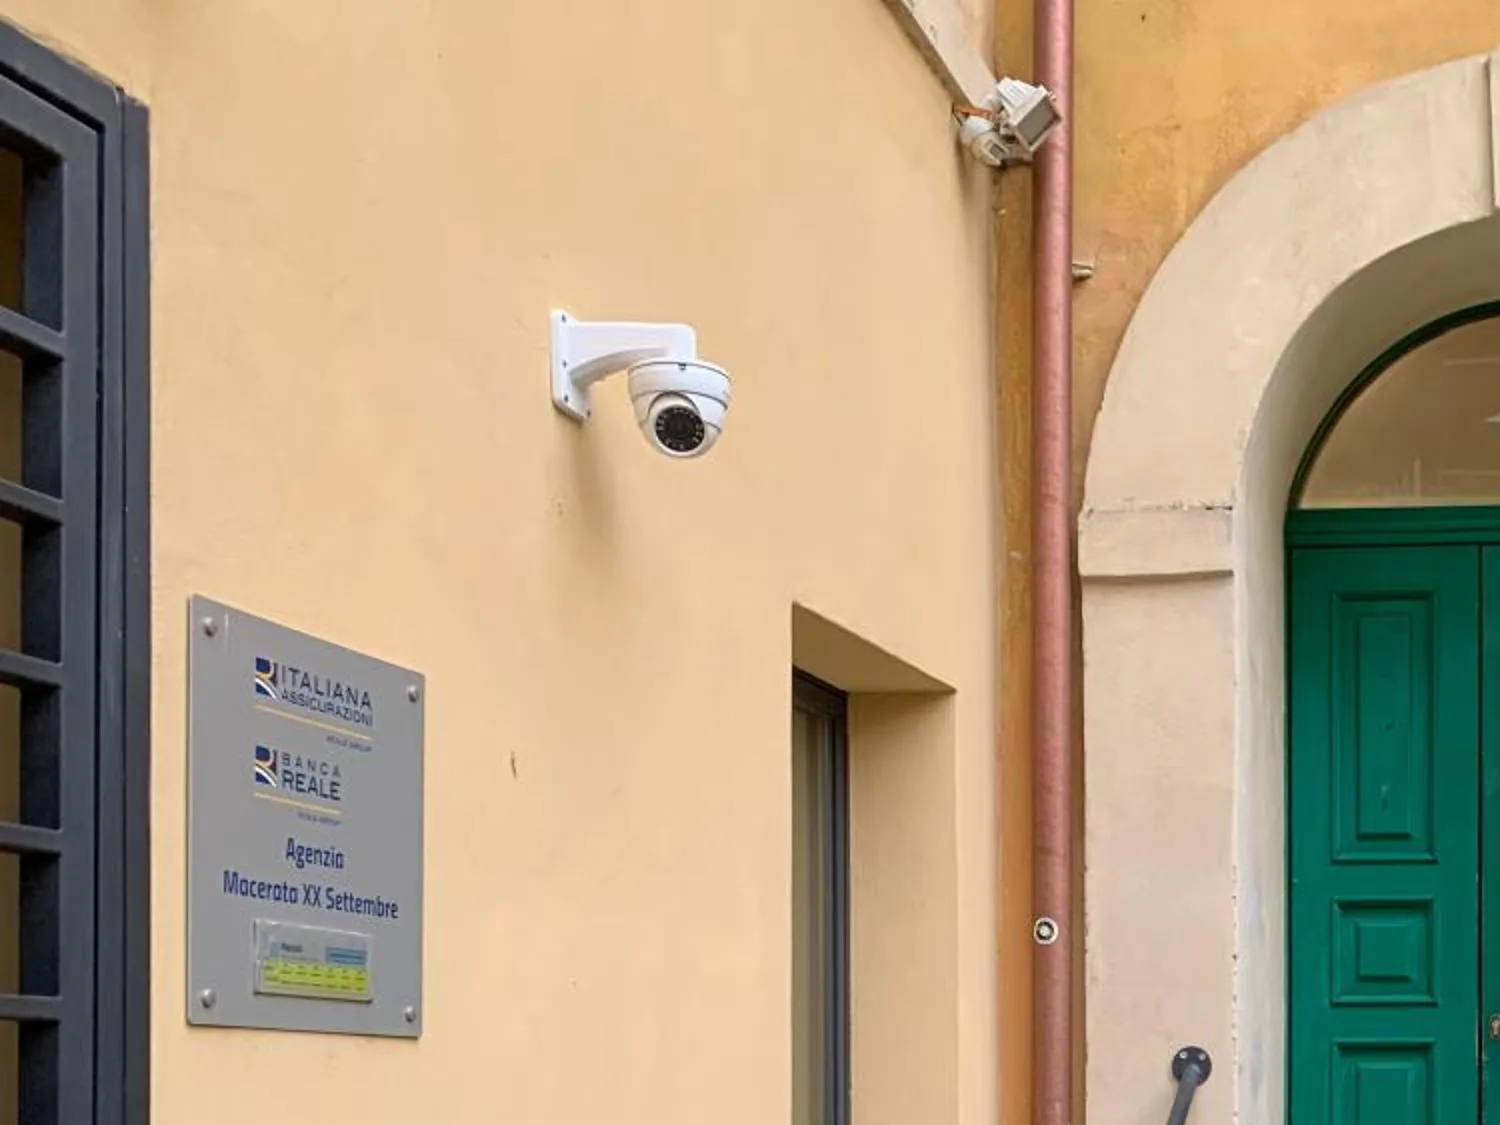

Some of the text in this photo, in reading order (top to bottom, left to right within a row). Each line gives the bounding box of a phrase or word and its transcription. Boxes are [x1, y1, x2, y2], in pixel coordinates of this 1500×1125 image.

[281, 664, 373, 711] ITALIANA
[281, 688, 374, 728] ASSICURAZIONI
[281, 751, 342, 778] BANCA
[281, 769, 342, 801] REALE
[285, 837, 345, 869] Agenzia
[223, 870, 399, 919] Macerata XX Settembre
